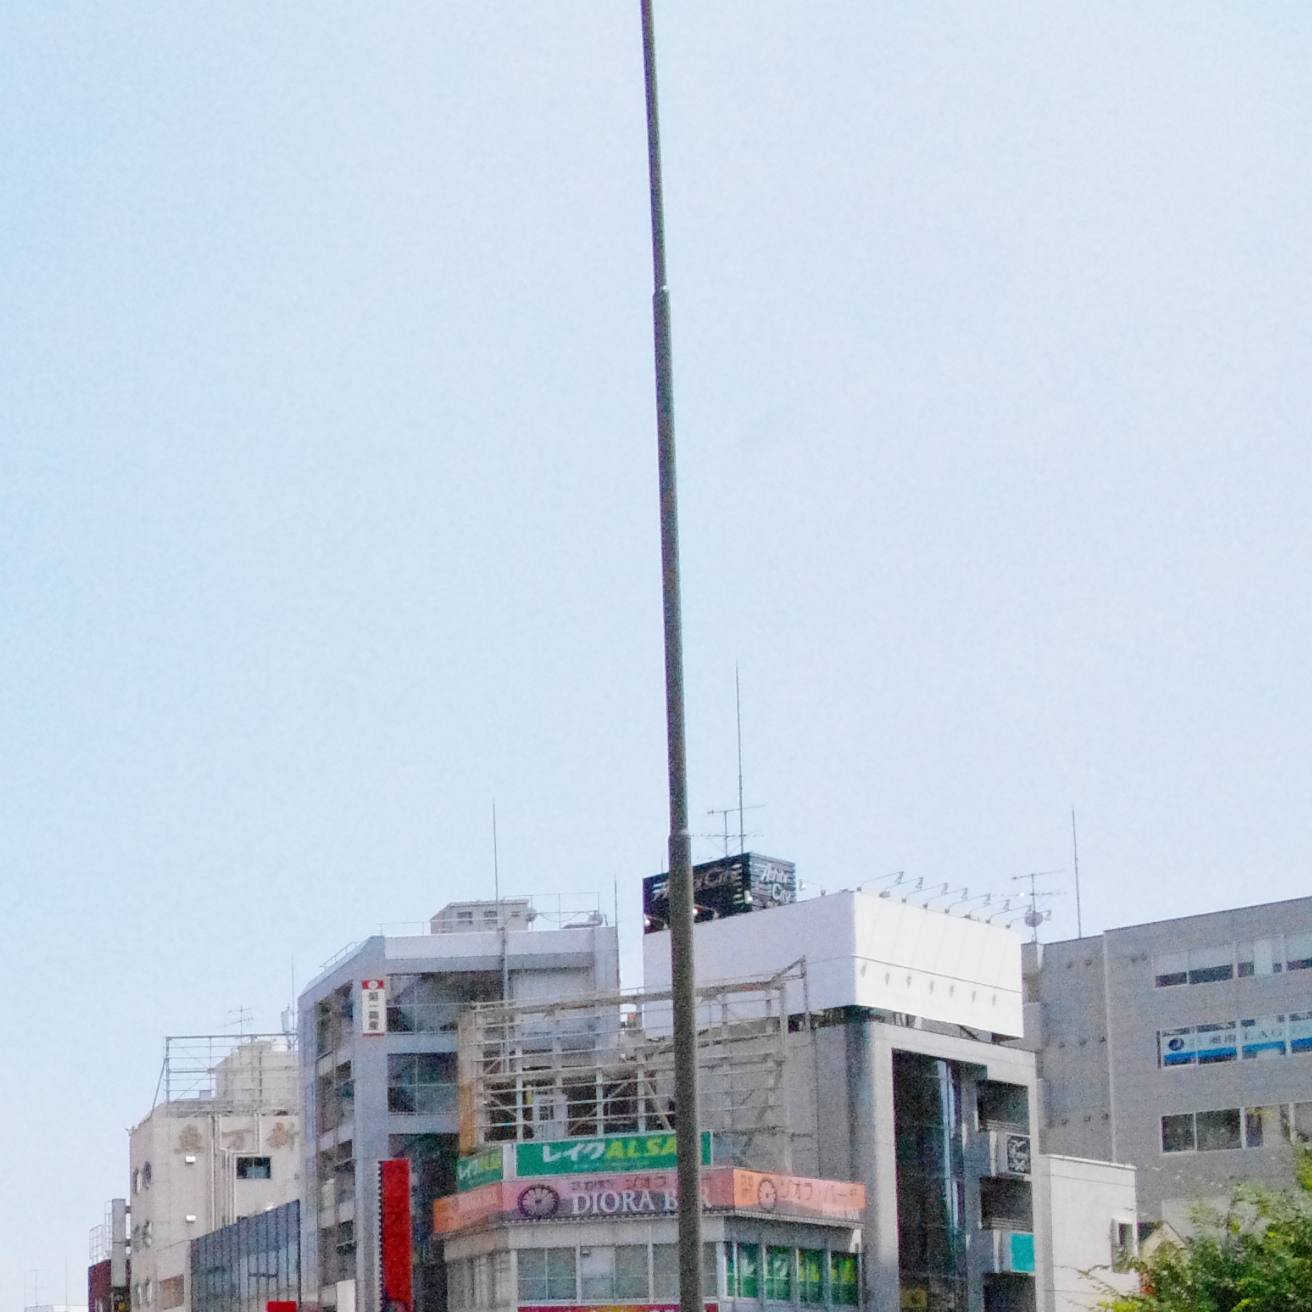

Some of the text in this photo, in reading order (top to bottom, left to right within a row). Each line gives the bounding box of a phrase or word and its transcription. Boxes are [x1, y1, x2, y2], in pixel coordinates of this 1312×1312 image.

[543, 1142, 605, 1162] レイク
[572, 1188, 656, 1214] DIORA
[664, 1186, 713, 1210] BR
